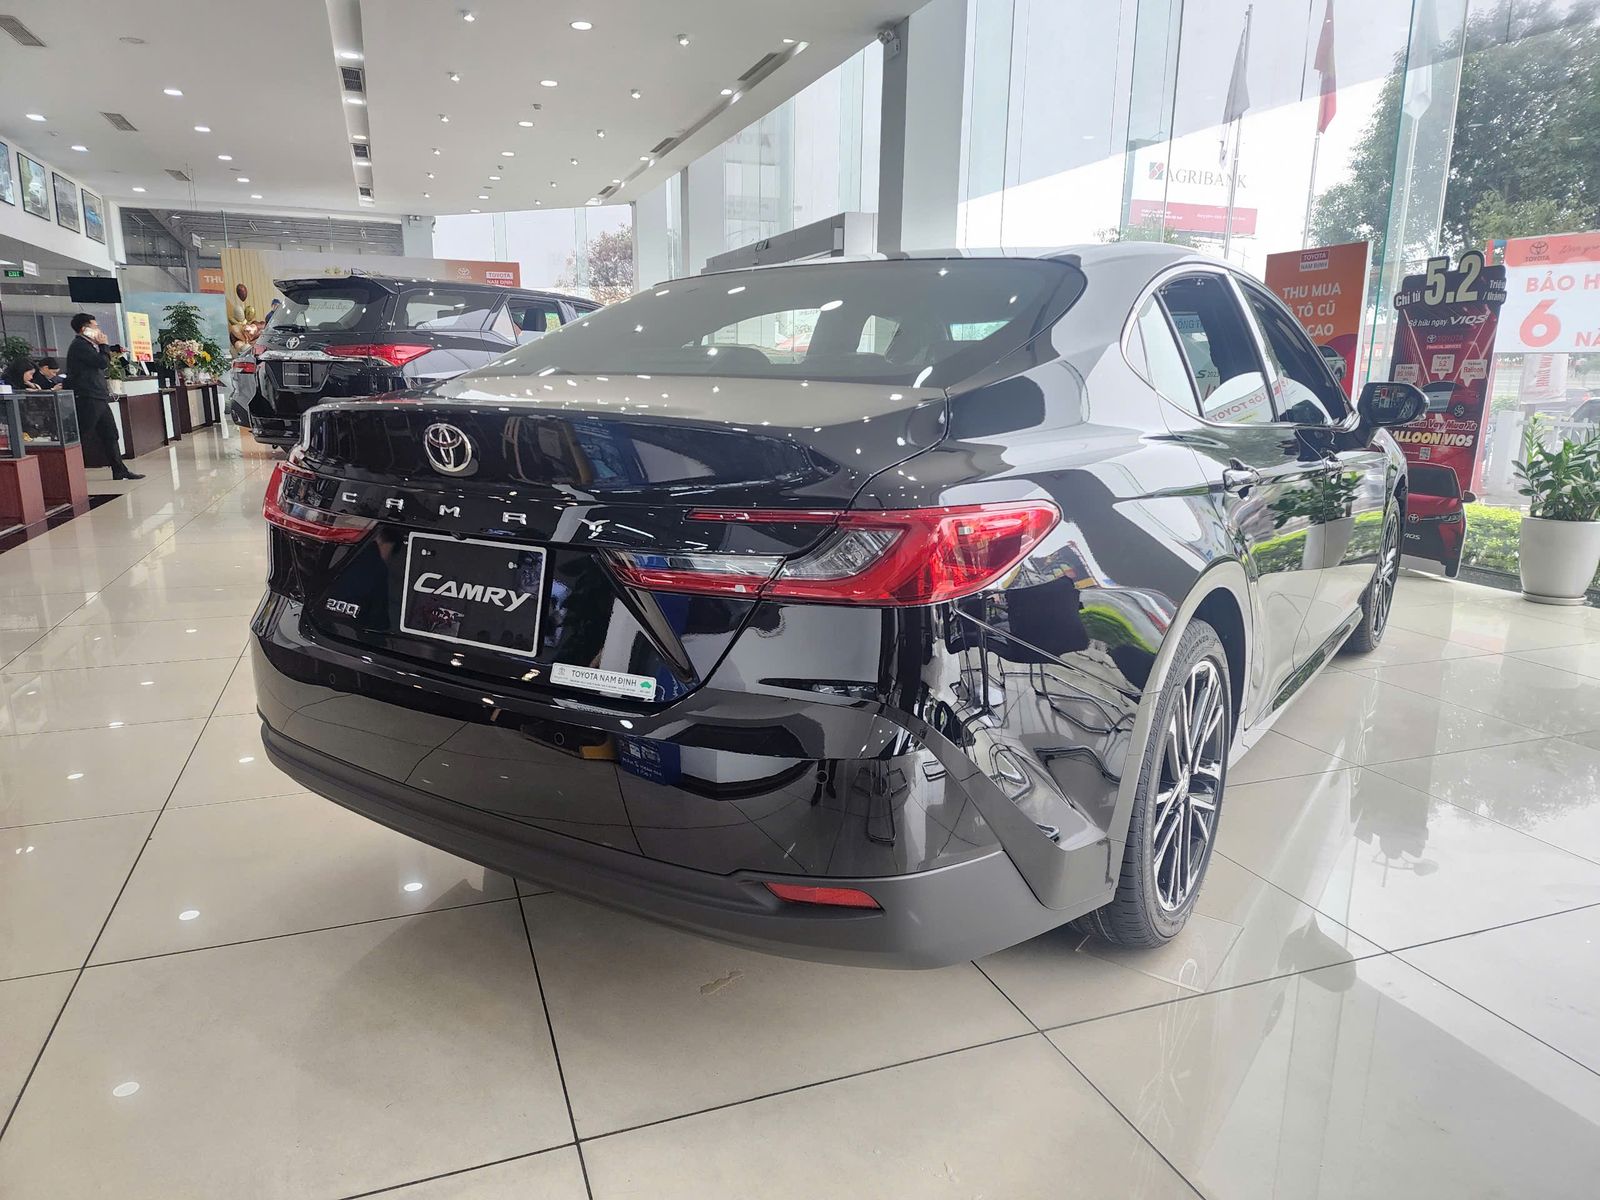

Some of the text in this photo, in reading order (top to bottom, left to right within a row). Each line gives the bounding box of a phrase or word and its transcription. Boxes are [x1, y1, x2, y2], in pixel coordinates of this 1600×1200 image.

[1166, 167, 1247, 189] AGRIBANK
[1303, 252, 1327, 261] TOYOTA
[203, 275, 224, 284] THU
[1424, 254, 1481, 306] 5.2
[1526, 270, 1576, 293] BẢO
[1283, 283, 1342, 299] THU MUA
[1297, 301, 1314, 318] TÔ
[1317, 300, 1336, 316] CŨ
[1307, 323, 1334, 338] CAO
[1519, 298, 1561, 348] 6
[1390, 429, 1474, 447] ALLOON VIOS
[342, 492, 610, 539] CAMRY
[413, 572, 532, 612] CAMRY
[571, 669, 598, 681] TOYOTA
[599, 674, 617, 684] NAM
[617, 677, 637, 688] ĐỊNH
